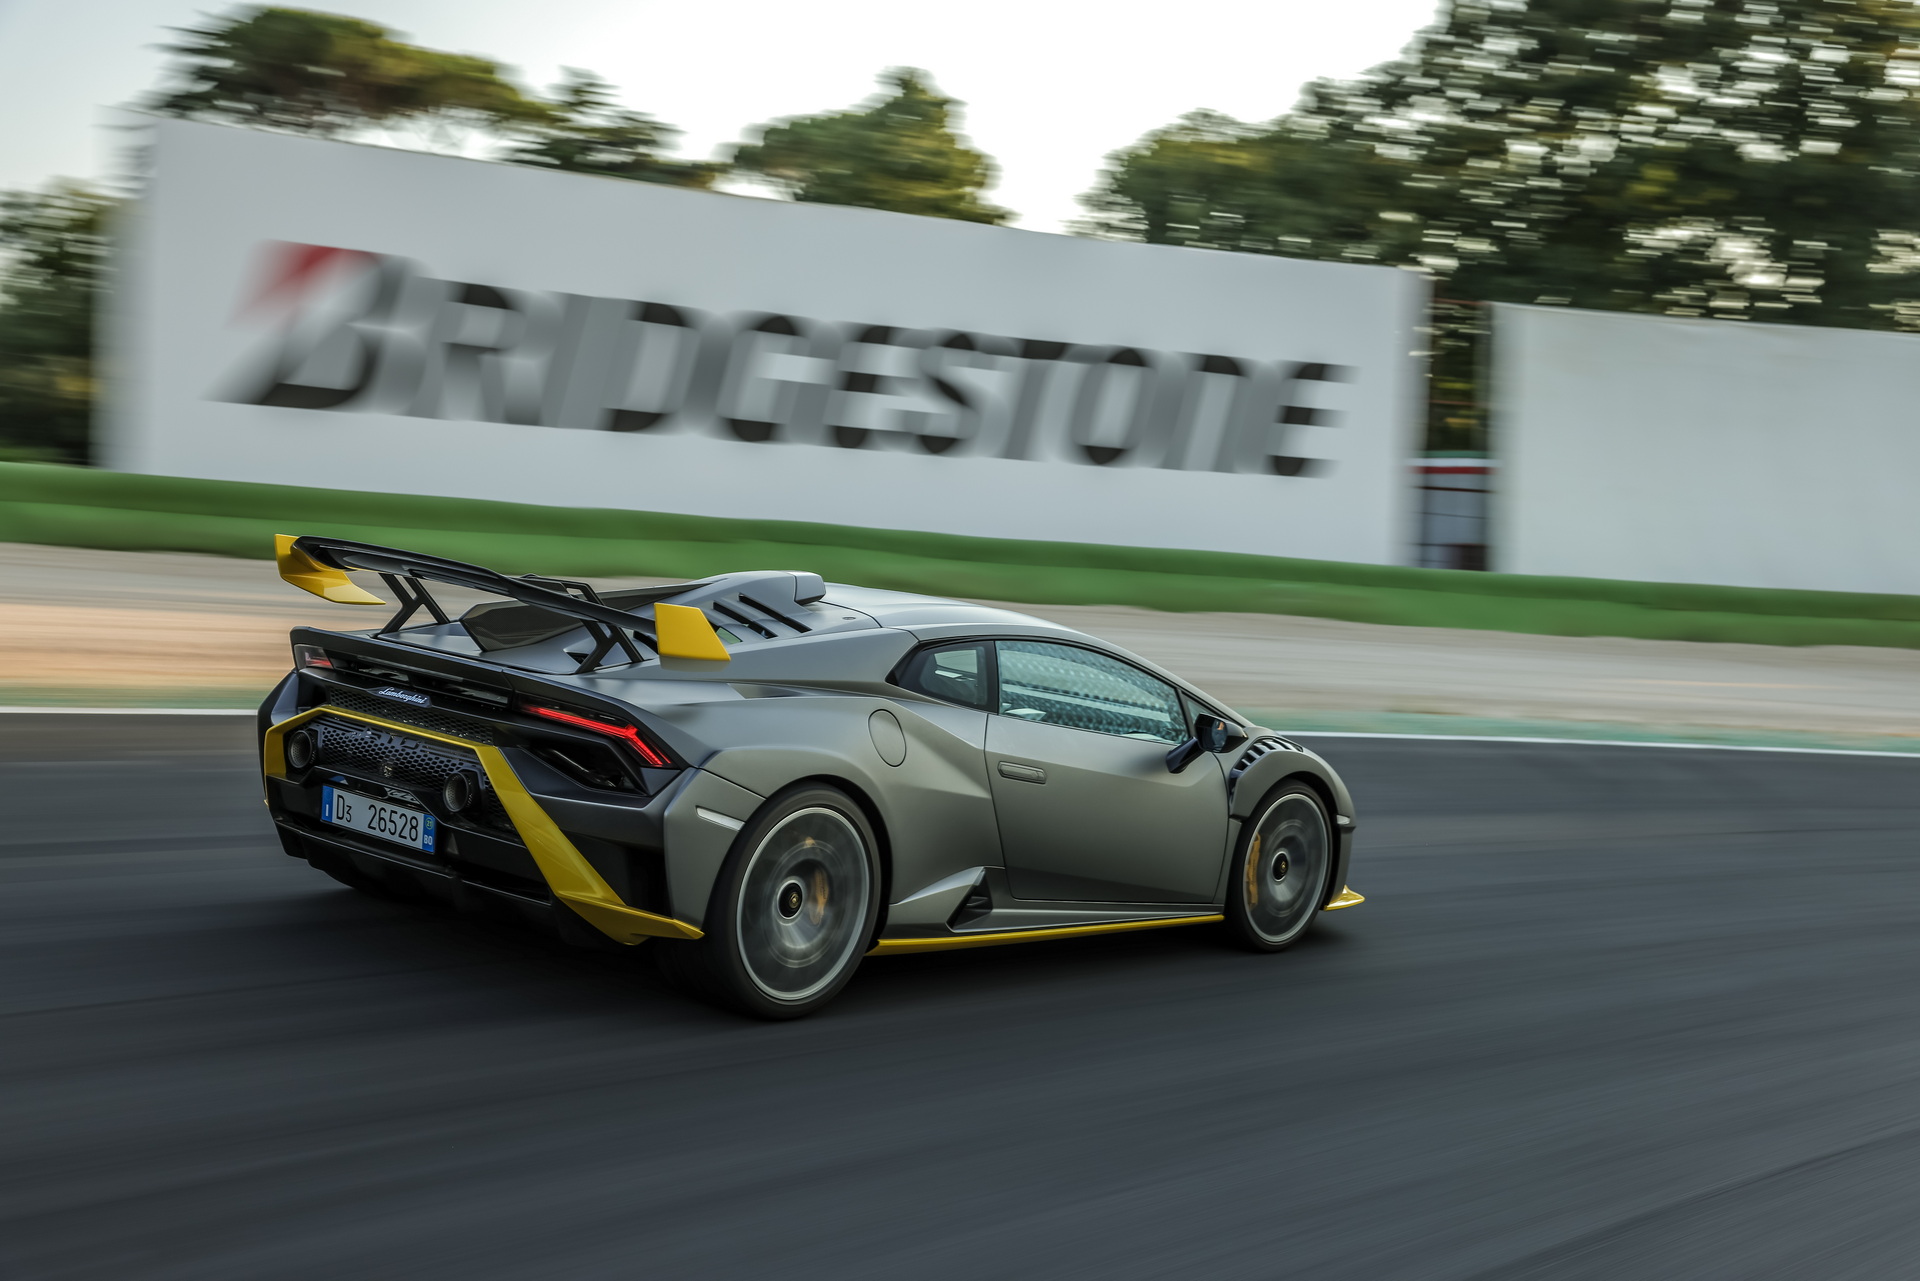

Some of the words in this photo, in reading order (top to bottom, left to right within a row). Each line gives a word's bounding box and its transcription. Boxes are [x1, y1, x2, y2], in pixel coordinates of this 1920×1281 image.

[218, 241, 1352, 478] BRIDGESTONE
[379, 686, 428, 704] Lamborghini
[336, 794, 352, 823] D3
[367, 804, 419, 842] 26528
[424, 834, 433, 846] BO
